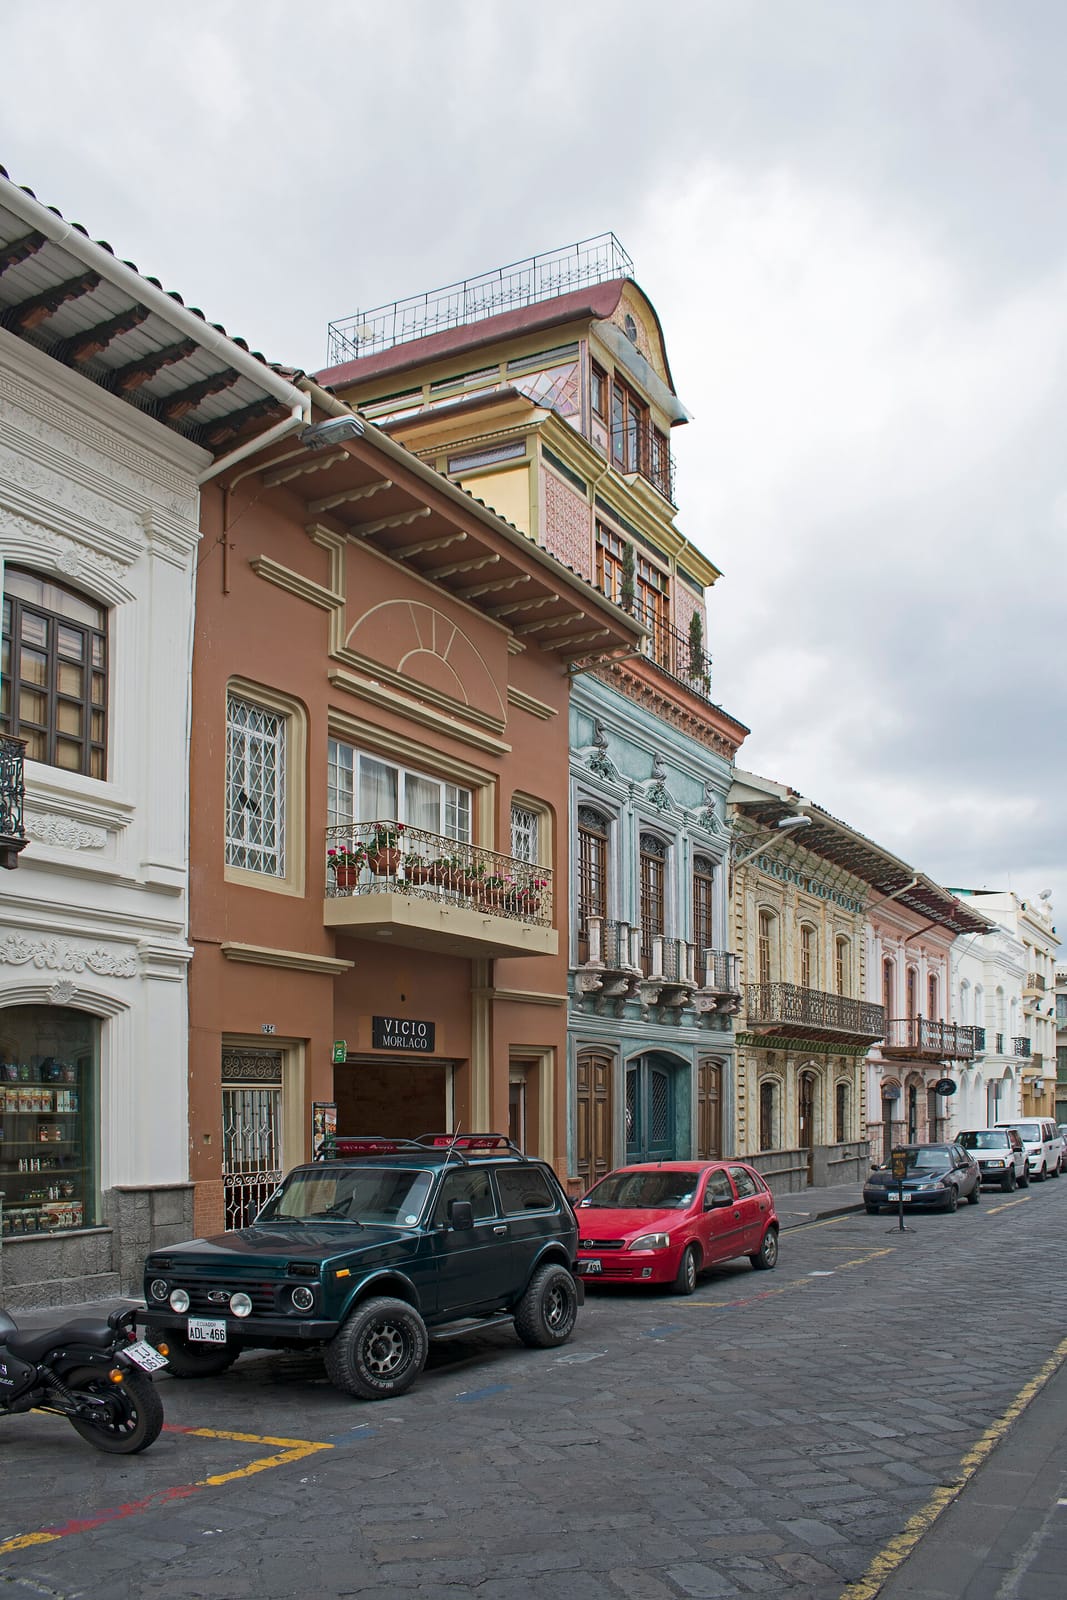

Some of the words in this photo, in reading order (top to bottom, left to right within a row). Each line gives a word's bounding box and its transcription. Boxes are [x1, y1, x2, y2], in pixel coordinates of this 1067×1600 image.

[384, 1019, 427, 1036] VICIO
[382, 1034, 428, 1049] MORLACO
[189, 1327, 225, 1341] ADL-466
